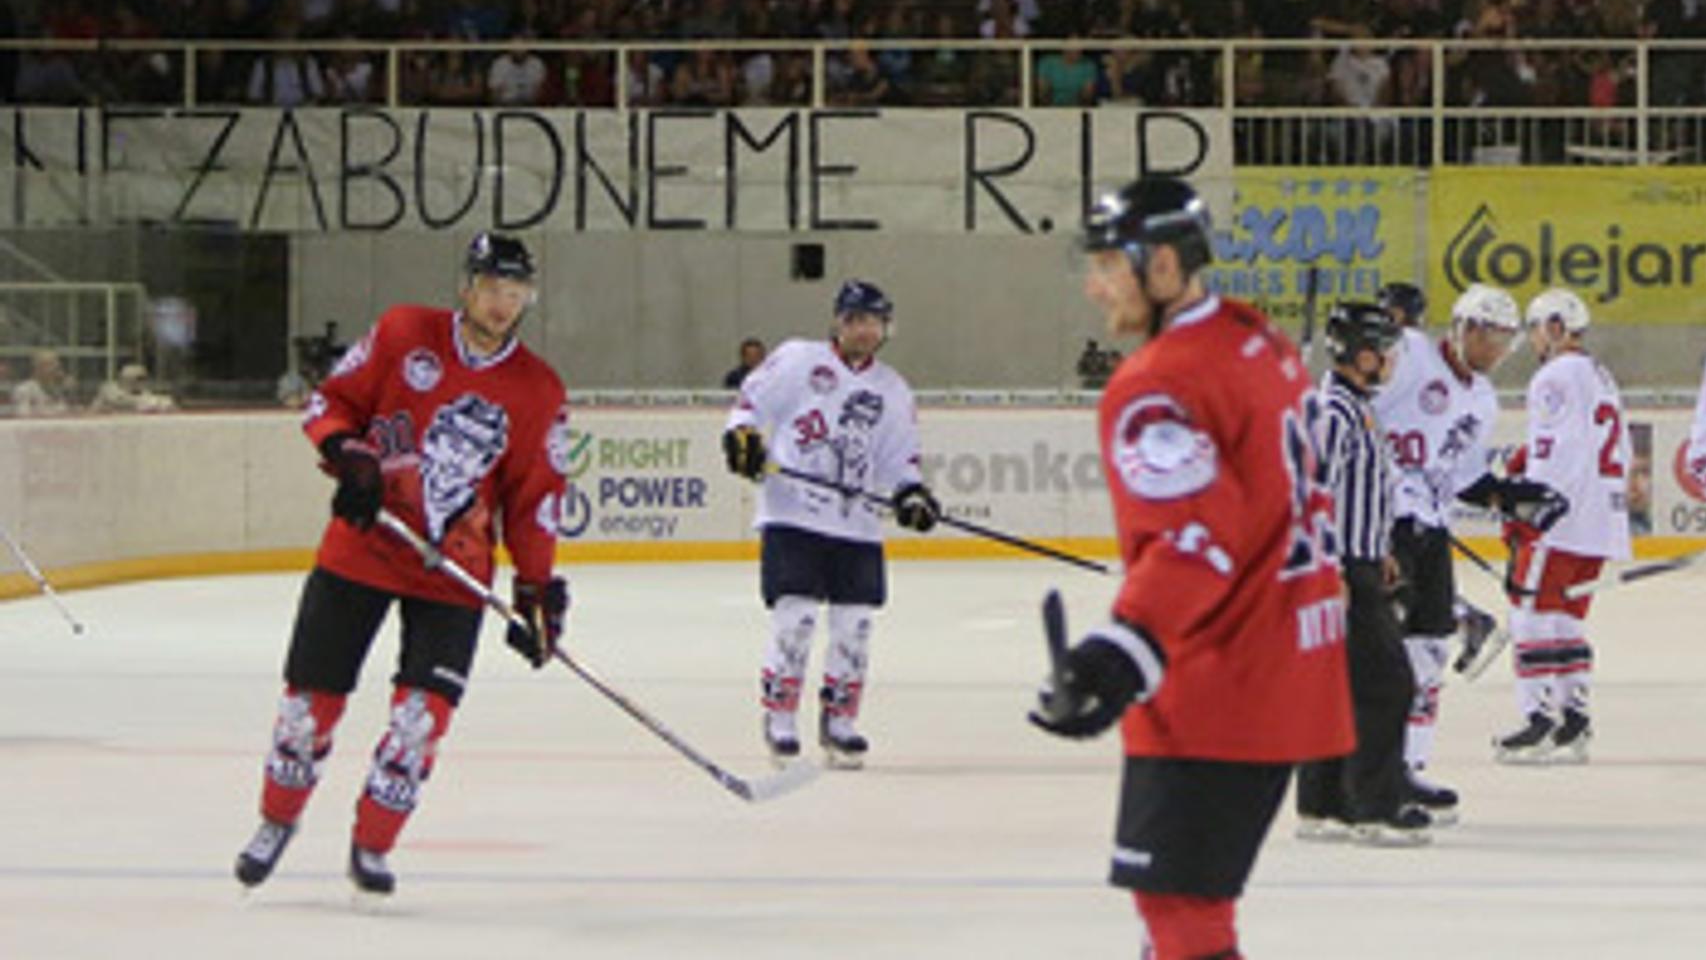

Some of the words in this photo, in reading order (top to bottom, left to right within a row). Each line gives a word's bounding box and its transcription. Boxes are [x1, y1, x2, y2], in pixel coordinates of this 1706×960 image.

[13, 108, 880, 233] NEZABUDNEME
[791, 409, 829, 447] 30
[599, 439, 689, 470] RIGHT
[599, 477, 706, 508] POWER
[598, 514, 679, 537] energy
